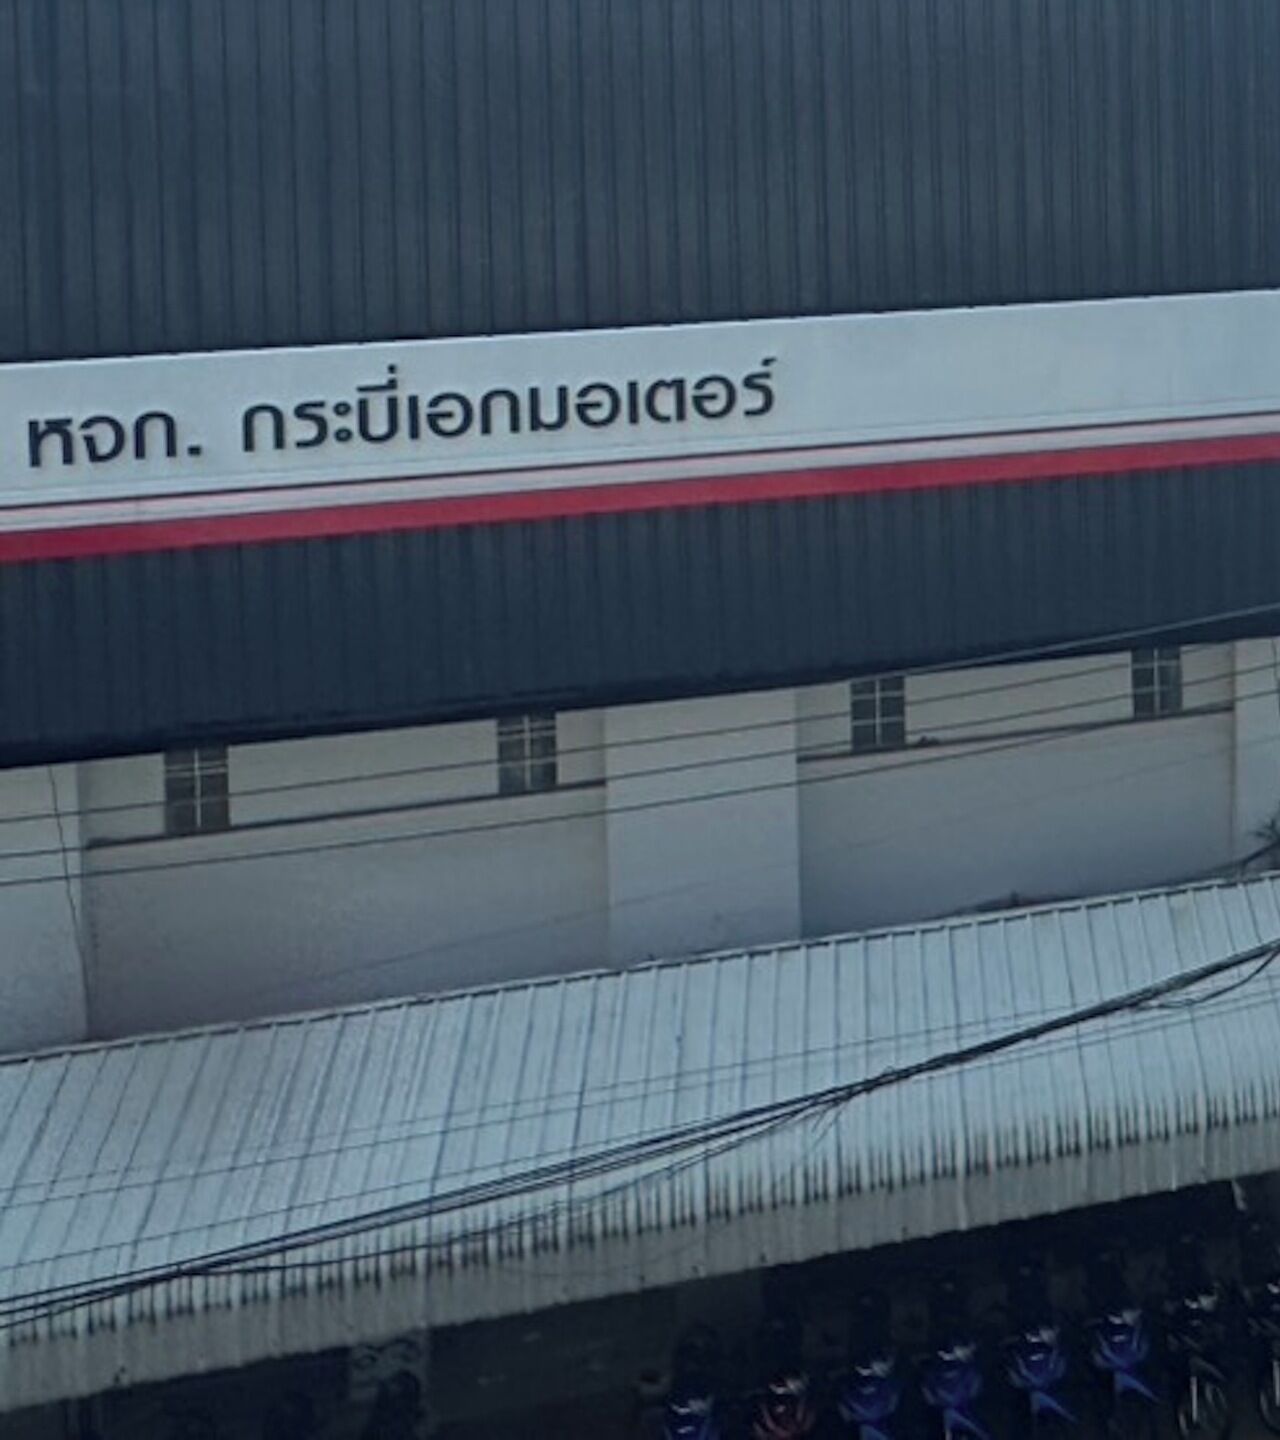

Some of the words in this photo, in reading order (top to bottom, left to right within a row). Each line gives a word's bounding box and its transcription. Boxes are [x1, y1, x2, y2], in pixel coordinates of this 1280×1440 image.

[27, 410, 202, 468] หจก.
[241, 357, 779, 453] กระบี่เอกมอเตอร์
